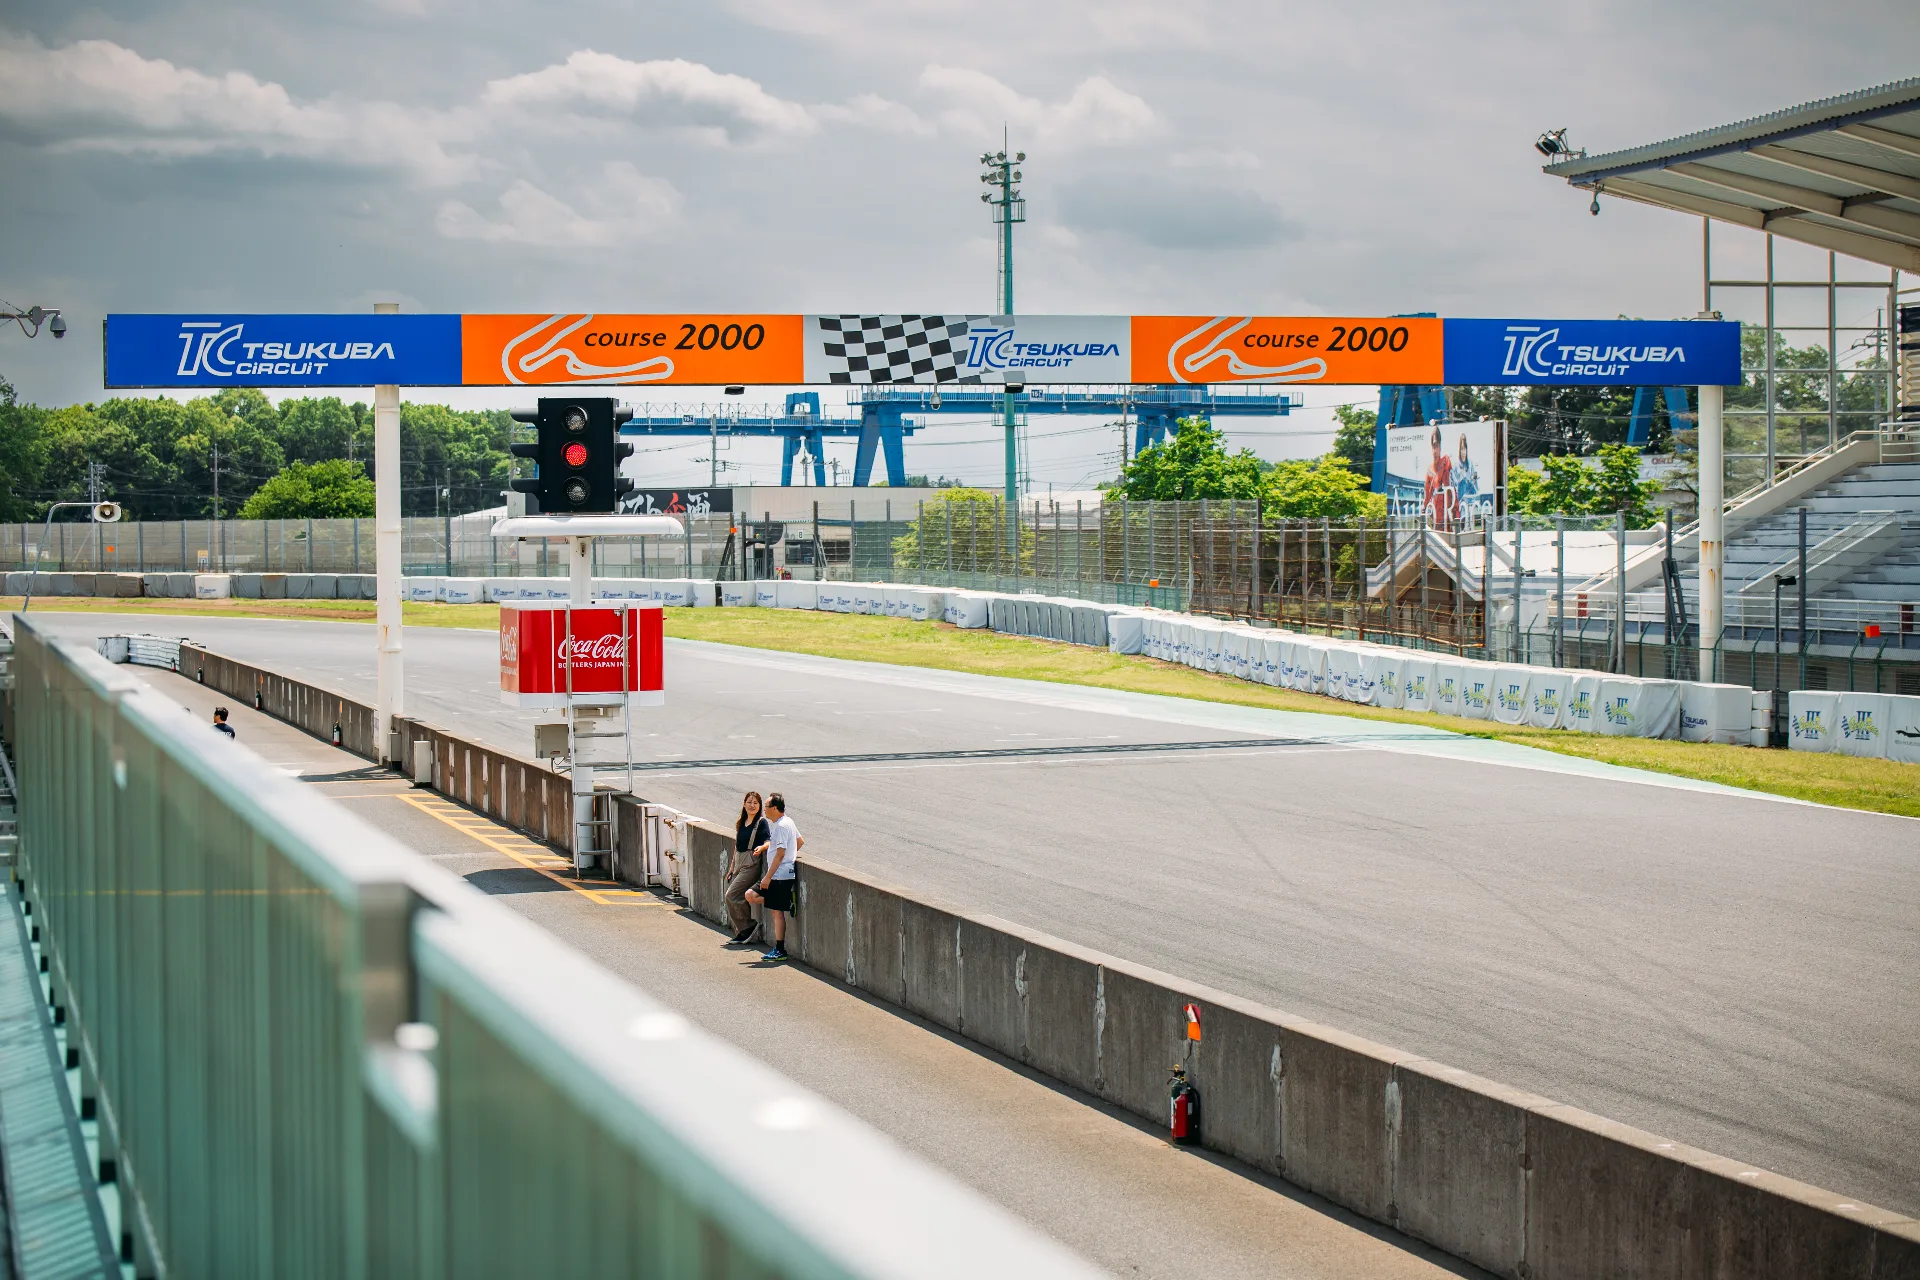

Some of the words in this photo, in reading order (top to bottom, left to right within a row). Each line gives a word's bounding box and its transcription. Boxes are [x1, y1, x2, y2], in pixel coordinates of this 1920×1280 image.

[584, 332, 667, 348] course
[674, 323, 765, 351] 2000
[1243, 333, 1319, 348] course
[1325, 326, 1409, 352] 2000
[242, 342, 395, 360] TSUKUBA
[1013, 343, 1120, 356] TSUKUBA
[1557, 345, 1686, 363] TSUKUBA
[557, 633, 634, 660] Coca-Cola
[594, 661, 616, 669] JAPAN
